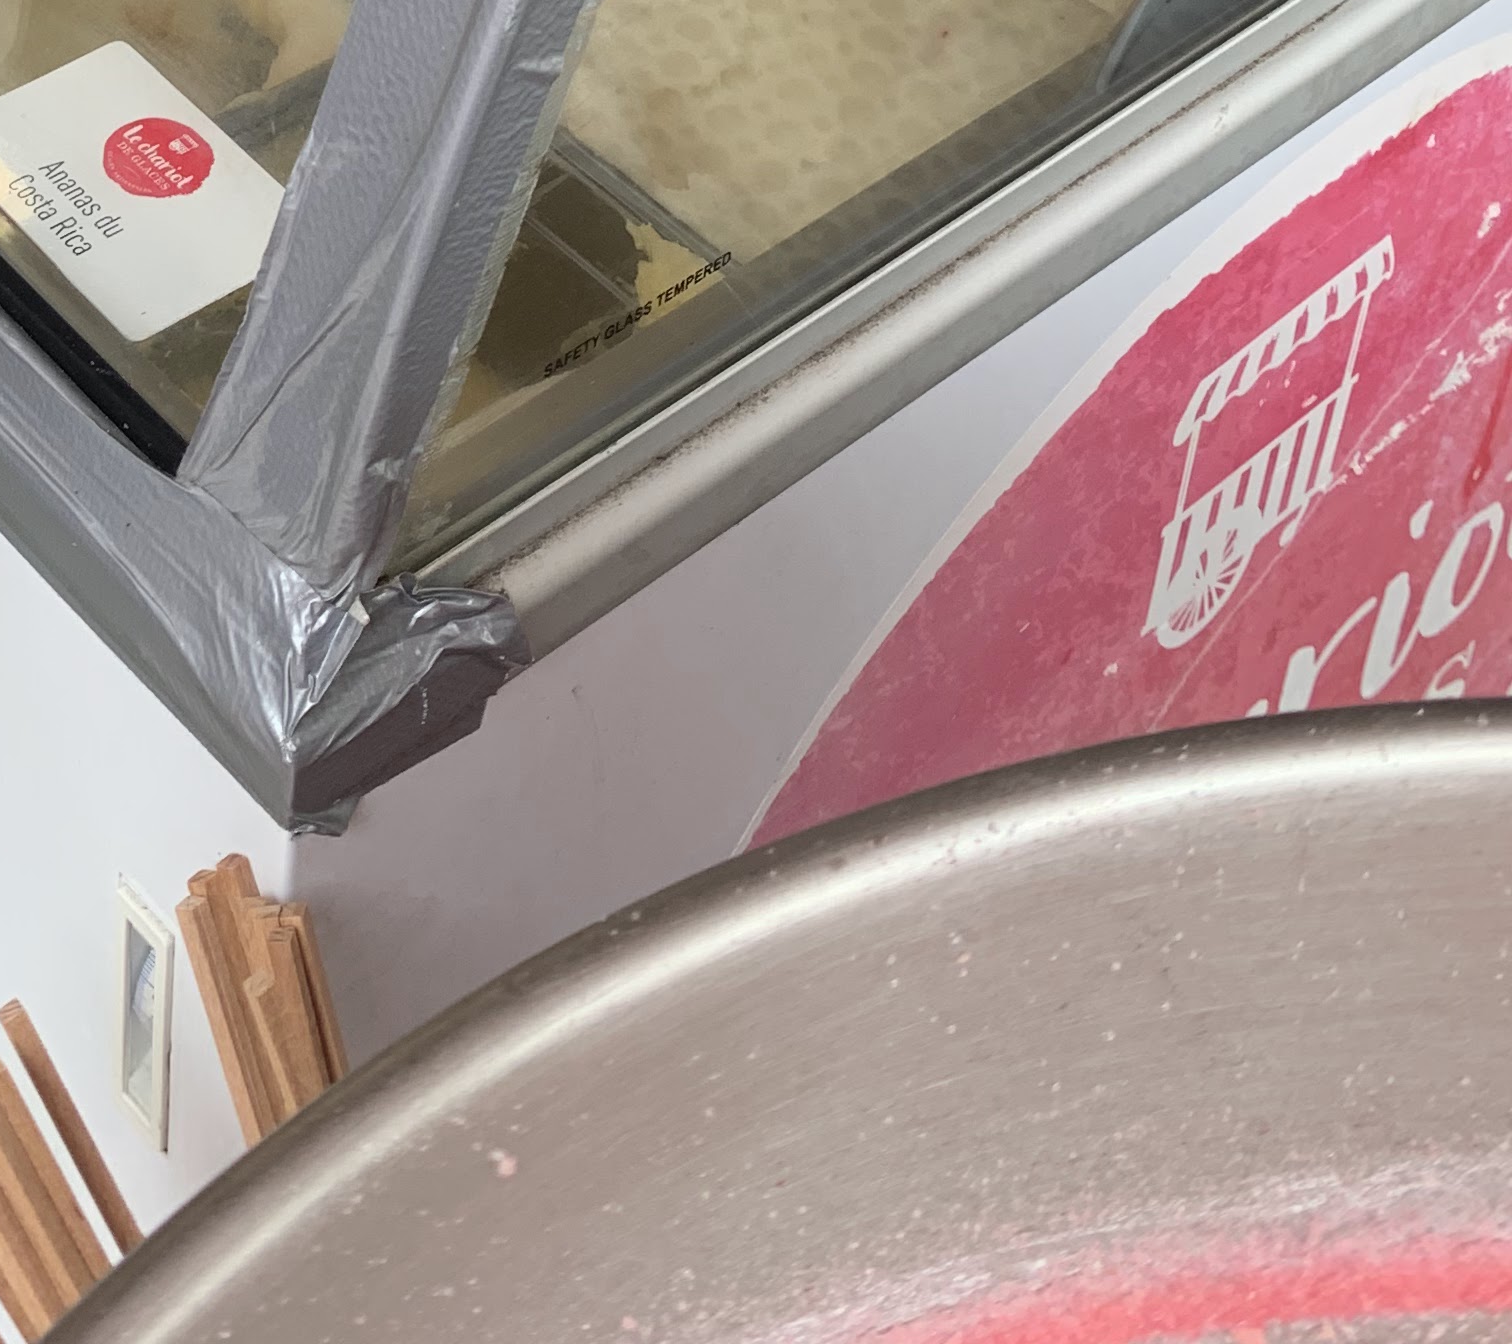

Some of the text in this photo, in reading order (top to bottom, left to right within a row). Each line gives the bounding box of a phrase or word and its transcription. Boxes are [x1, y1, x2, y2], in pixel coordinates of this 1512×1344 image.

[121, 123, 148, 147] Le
[138, 138, 195, 191] chariot
[129, 154, 173, 193] GLACES
[7, 173, 94, 257] Costa Rica
[38, 159, 101, 218] Ananas
[94, 212, 125, 239] du
[542, 250, 733, 379] SAFETY GLASS TEMPERED
